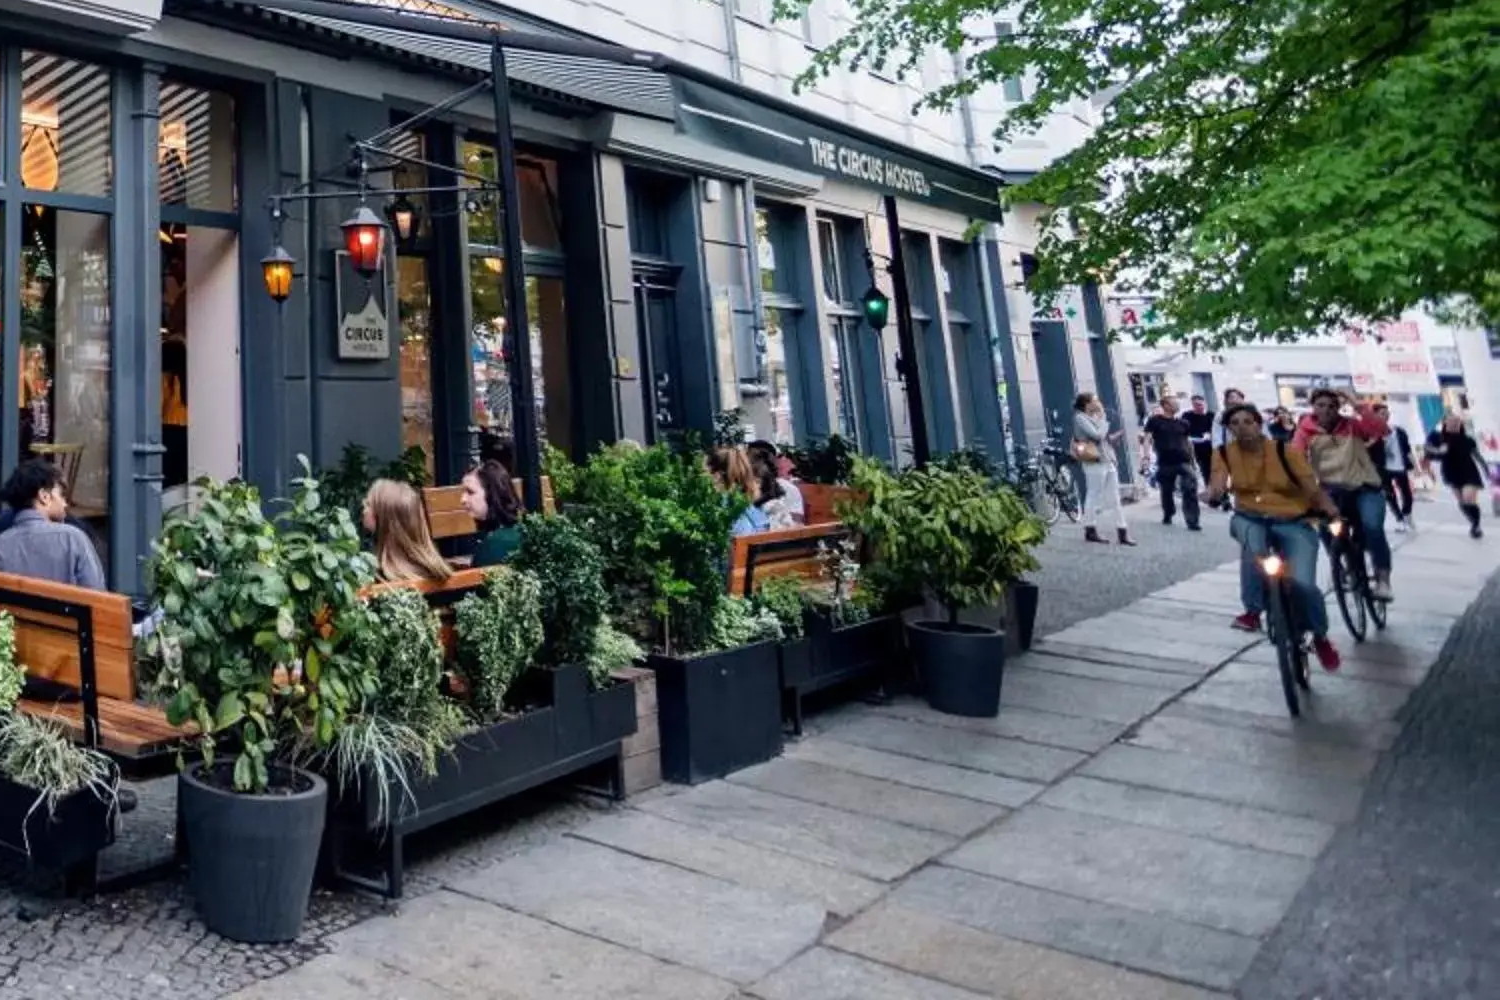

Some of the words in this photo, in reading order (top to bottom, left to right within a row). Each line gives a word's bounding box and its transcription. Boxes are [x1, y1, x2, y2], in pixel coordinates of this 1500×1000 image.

[808, 136, 838, 171] THE
[838, 146, 884, 184] CIRCUS
[885, 160, 931, 197] HOSTEL
[345, 327, 384, 341] CIRCUS
